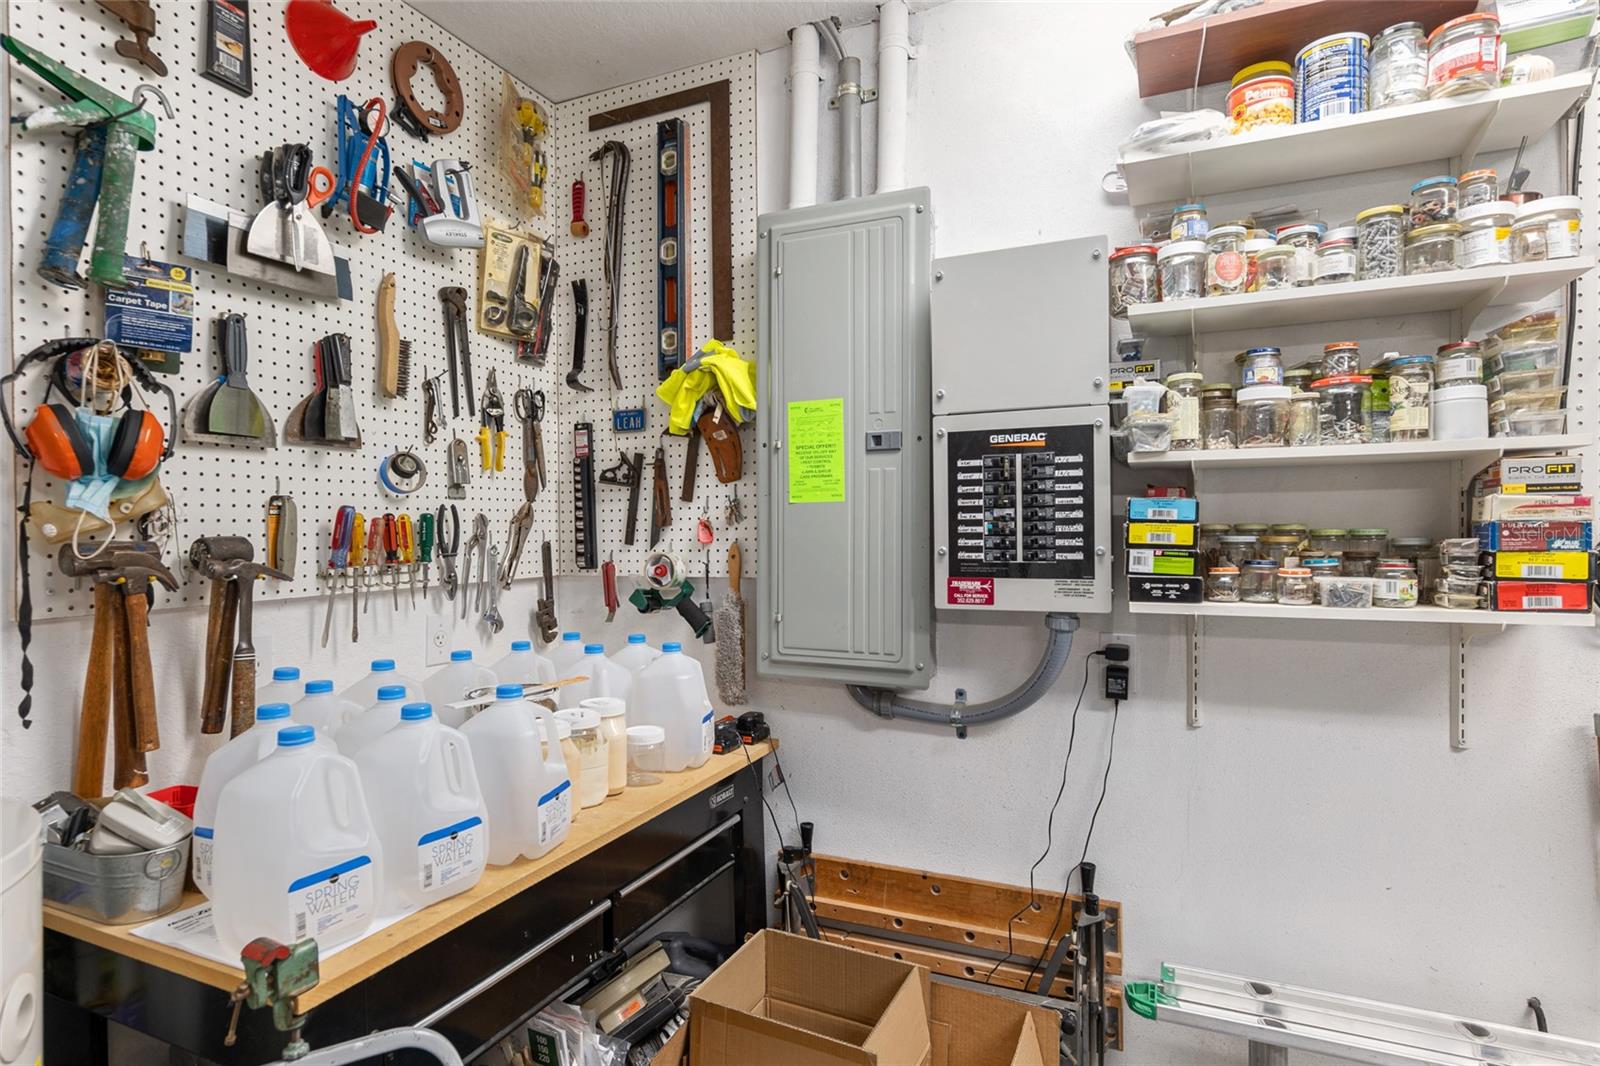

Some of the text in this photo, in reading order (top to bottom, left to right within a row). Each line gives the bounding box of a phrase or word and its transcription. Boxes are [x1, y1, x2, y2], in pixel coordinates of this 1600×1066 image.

[1245, 86, 1289, 104] Peanuts
[107, 293, 168, 310] Carpet Tape
[1110, 364, 1153, 375] PRO FIT
[616, 416, 641, 430] LEAH
[989, 432, 1046, 444] GENERAC
[1508, 464, 1574, 474] PRO FIT
[716, 787, 734, 803] KOBALT
[432, 833, 473, 858] SPRING
[432, 844, 472, 867] WATER
[305, 875, 360, 905] SPRING
[305, 888, 359, 916] WATER
[536, 1034, 548, 1046] 100
[538, 1053, 550, 1064] 220
